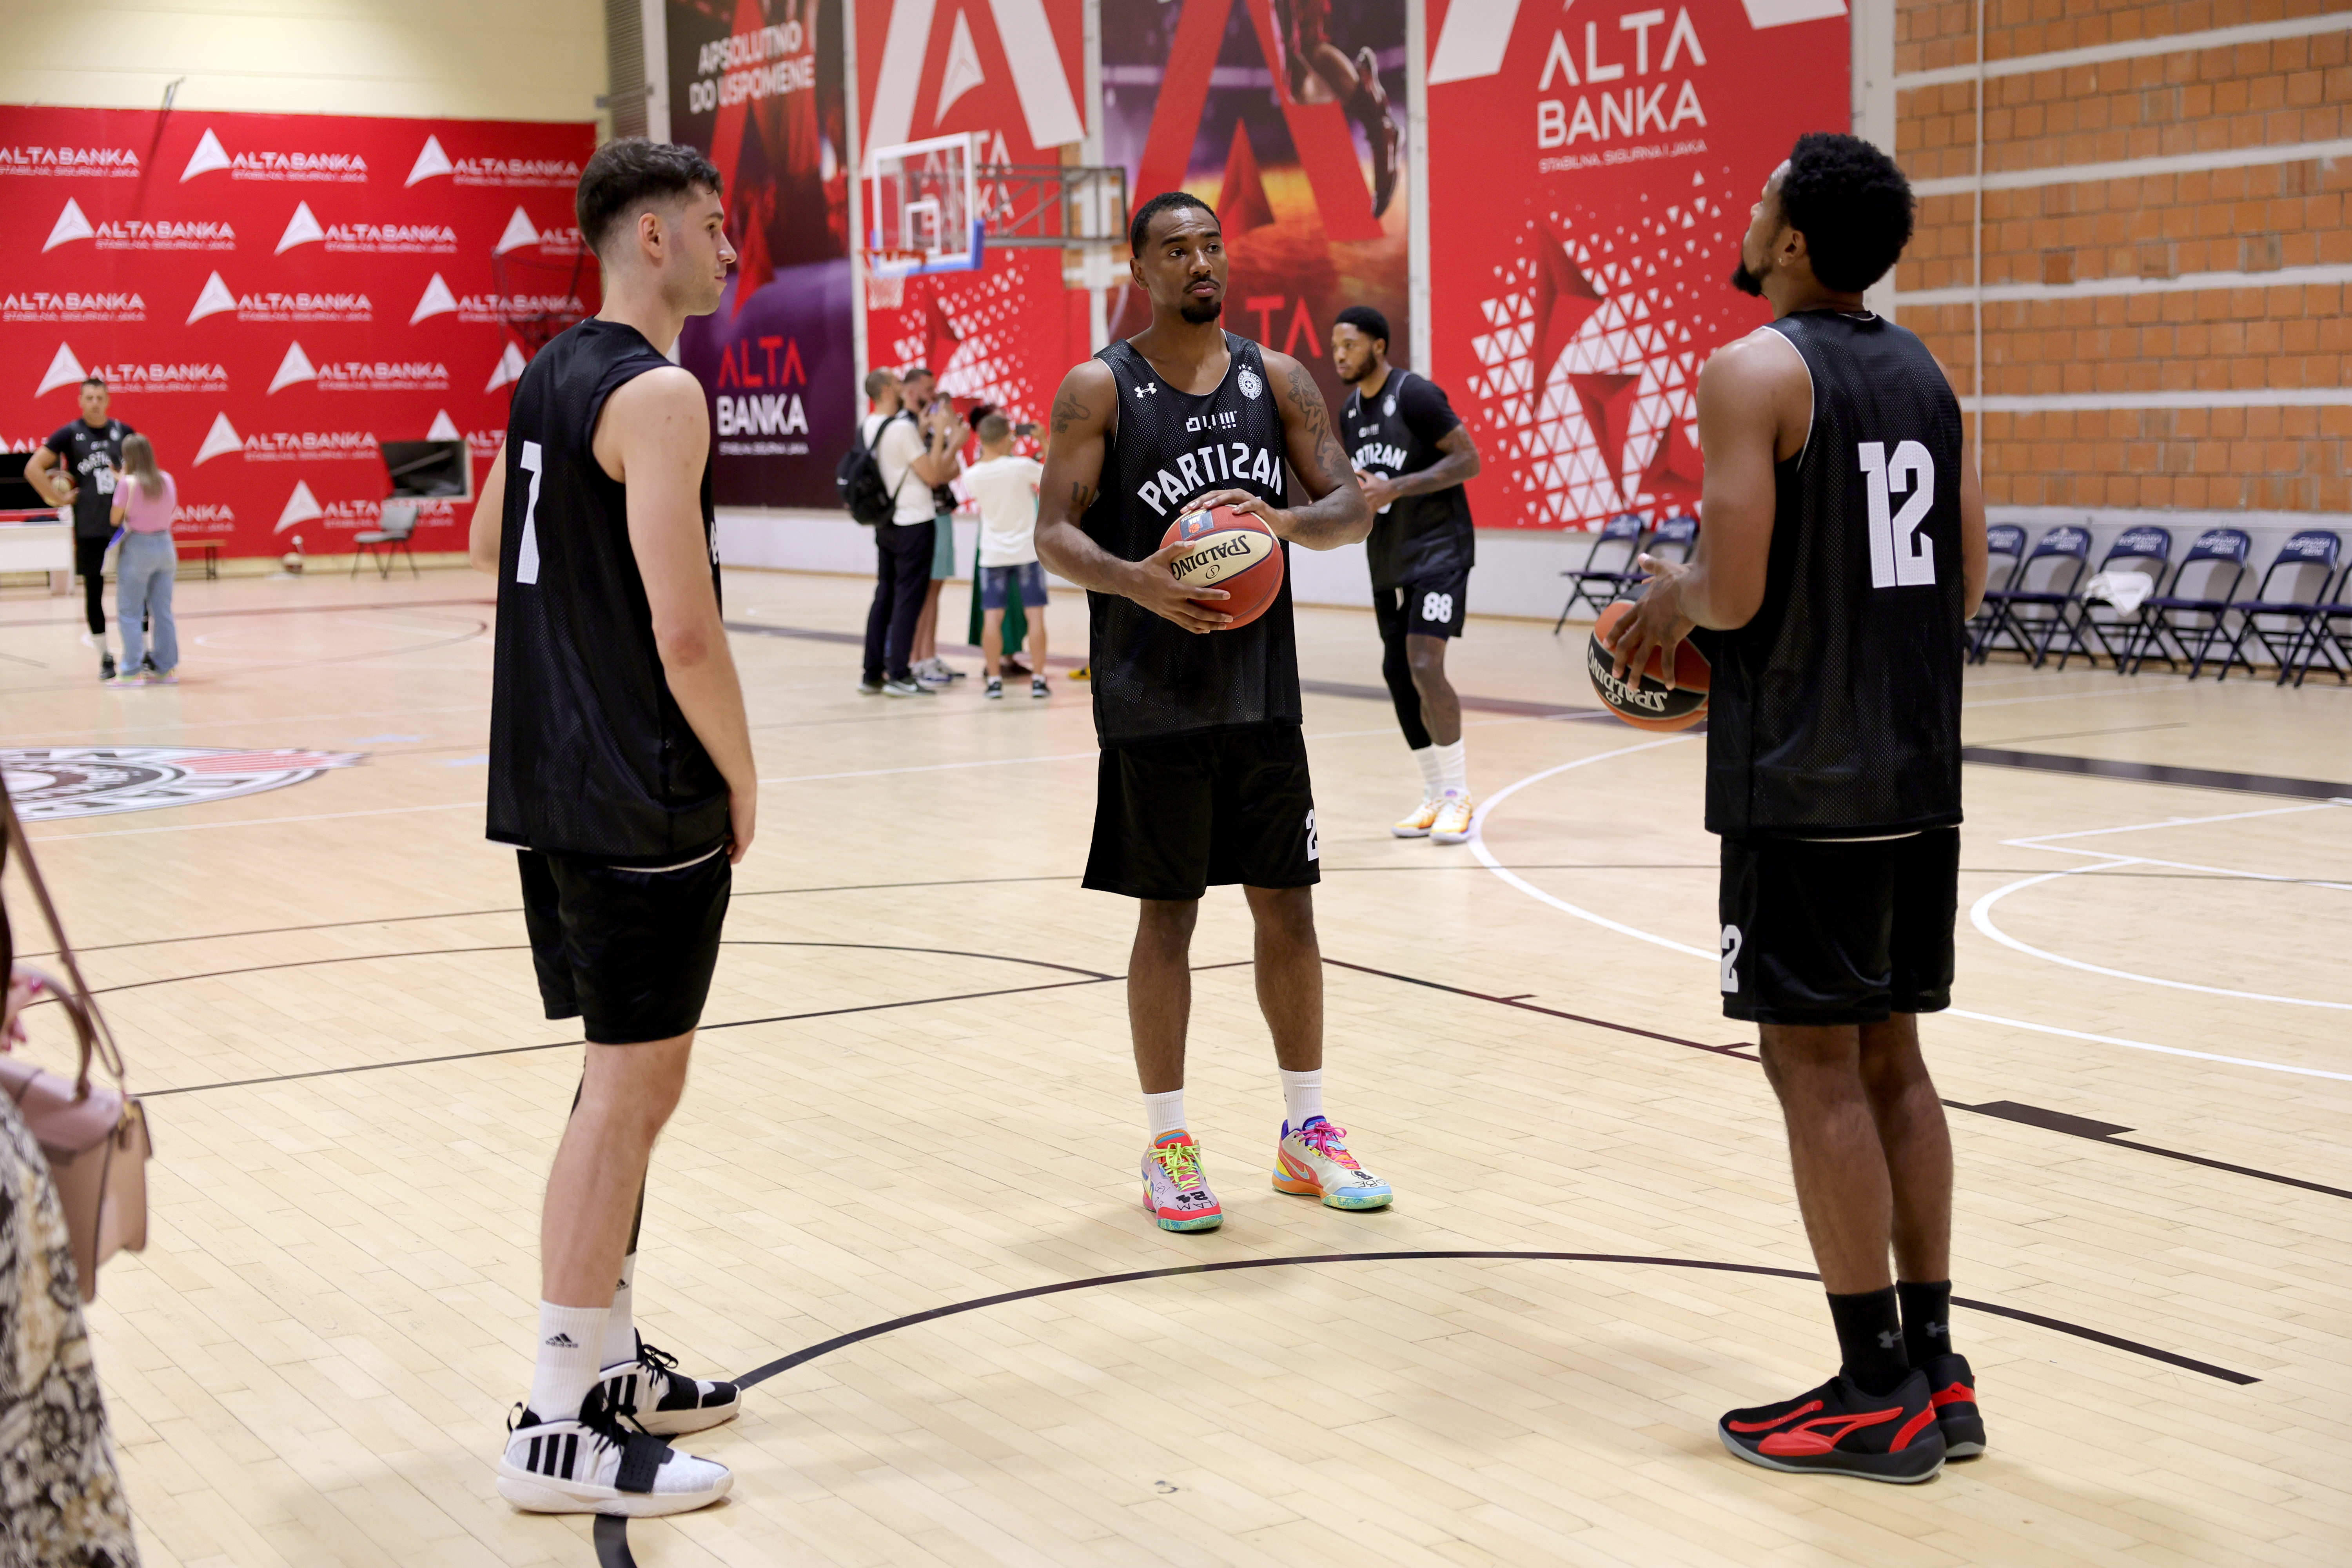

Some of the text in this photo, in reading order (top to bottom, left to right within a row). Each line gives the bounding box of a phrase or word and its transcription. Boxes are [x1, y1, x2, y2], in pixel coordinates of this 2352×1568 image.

[697, 20, 802, 76] APSOLUTNO
[1537, 5, 1708, 93] ALTA
[689, 54, 816, 114] DO USPOMENE
[1537, 78, 1708, 149] BANKA
[0, 146, 140, 166] ALTABANKA
[231, 151, 368, 170] ALTABANKA
[453, 157, 580, 176] ALTABANKA
[95, 220, 236, 239] ALTABANKA
[325, 223, 457, 242] ALTABANKA
[3, 292, 146, 310] ALTABANKA
[237, 293, 372, 311] ALTABANKA
[90, 363, 229, 382] ALTABANKA
[317, 362, 449, 380] ALTABANKA
[717, 334, 807, 389] ALTA
[717, 393, 809, 436] BANKA
[245, 432, 378, 450] ALTABANKA
[1350, 442, 1408, 472] ARTIZAN
[1137, 443, 1282, 516] PARTIZAN
[1188, 515, 1201, 525] ABA
[1858, 440, 1936, 588] 12
[1171, 535, 1250, 581] SPALDING
[1422, 592, 1453, 624] 88
